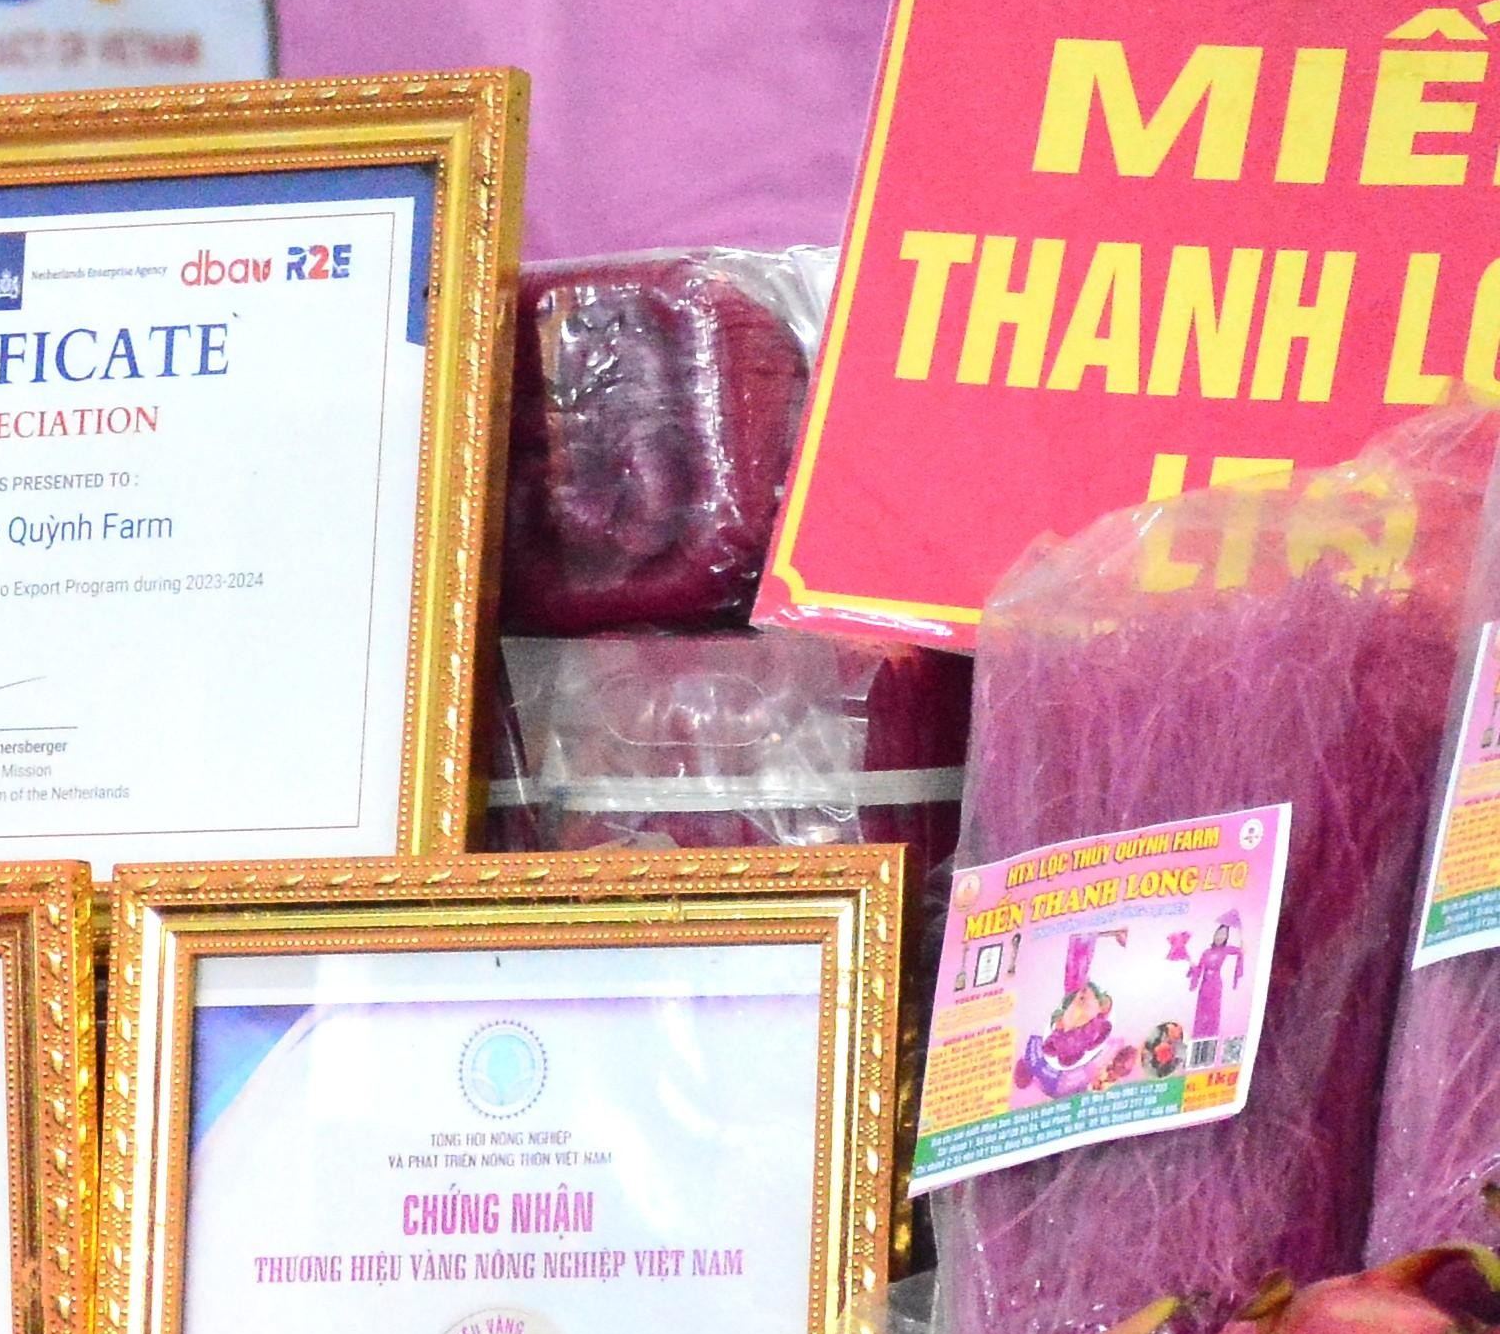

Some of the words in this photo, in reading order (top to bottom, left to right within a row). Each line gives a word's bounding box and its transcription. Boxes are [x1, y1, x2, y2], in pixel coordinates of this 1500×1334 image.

[285, 244, 353, 282] R2E
[895, 229, 1356, 405] THANH
[12, 472, 104, 492] PRESENTED
[7, 513, 93, 552] Quỳnh
[102, 512, 174, 540] Farm
[1134, 451, 1418, 597] LTQ
[14, 579, 62, 598] Export
[64, 578, 130, 597] Program
[134, 575, 182, 594] during
[185, 571, 265, 590] 2023-2024
[1005, 861, 1036, 890] HTX
[1038, 852, 1070, 882] LỘC
[1114, 831, 1170, 862] QUỲNH
[1173, 826, 1222, 852] FARM
[963, 892, 1026, 943] MIẾN
[1030, 877, 1122, 924] THANH
[1124, 866, 1199, 901] LONG
[1201, 860, 1250, 892] LTQ
[1206, 1069, 1240, 1088] 1kg
[403, 1182, 500, 1236] CHỨNG
[511, 1183, 594, 1241] NHẬN
[254, 1254, 342, 1284] THƯƠNG
[349, 1250, 402, 1287] HIỆU
[410, 1247, 467, 1282] VÀNG
[474, 1248, 536, 1281] NÔNG
[543, 1247, 626, 1285] NGHIỆP
[634, 1247, 685, 1283] VIỆT
[692, 1248, 746, 1277] NAM
